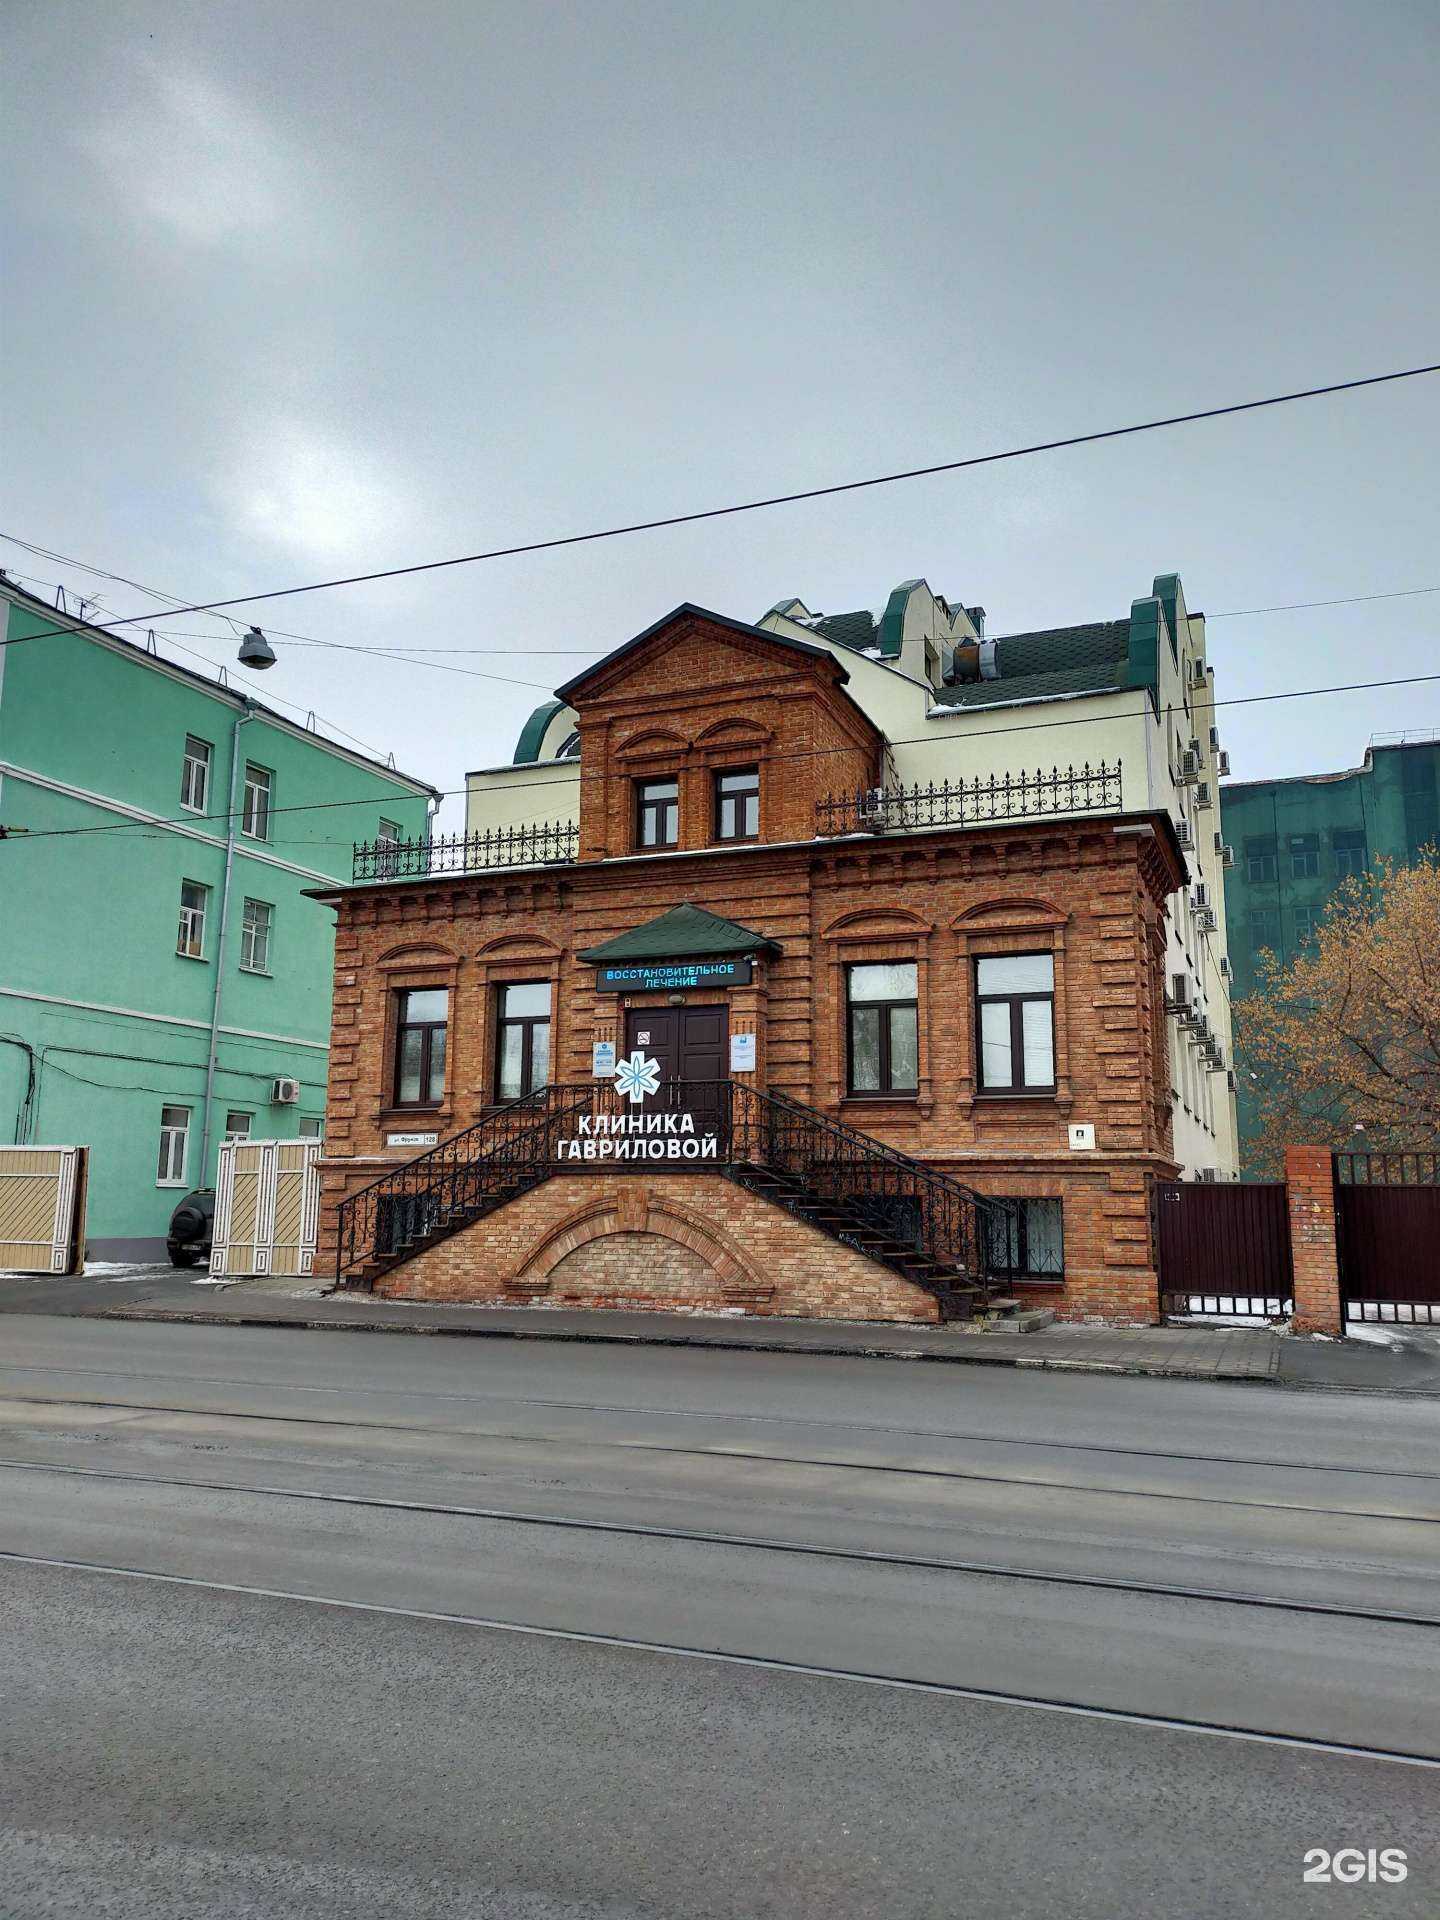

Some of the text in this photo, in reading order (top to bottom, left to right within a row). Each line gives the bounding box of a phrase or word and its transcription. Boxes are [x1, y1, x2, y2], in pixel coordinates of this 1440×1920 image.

[606, 964, 735, 980] ВОССТАНОВИТЕЛЬНОЕ
[645, 976, 698, 988] ЛЕЧЕНИЕ
[578, 1113, 695, 1135] КЛИНИКА
[557, 1132, 717, 1160] ГАВРИЛОВОЙ
